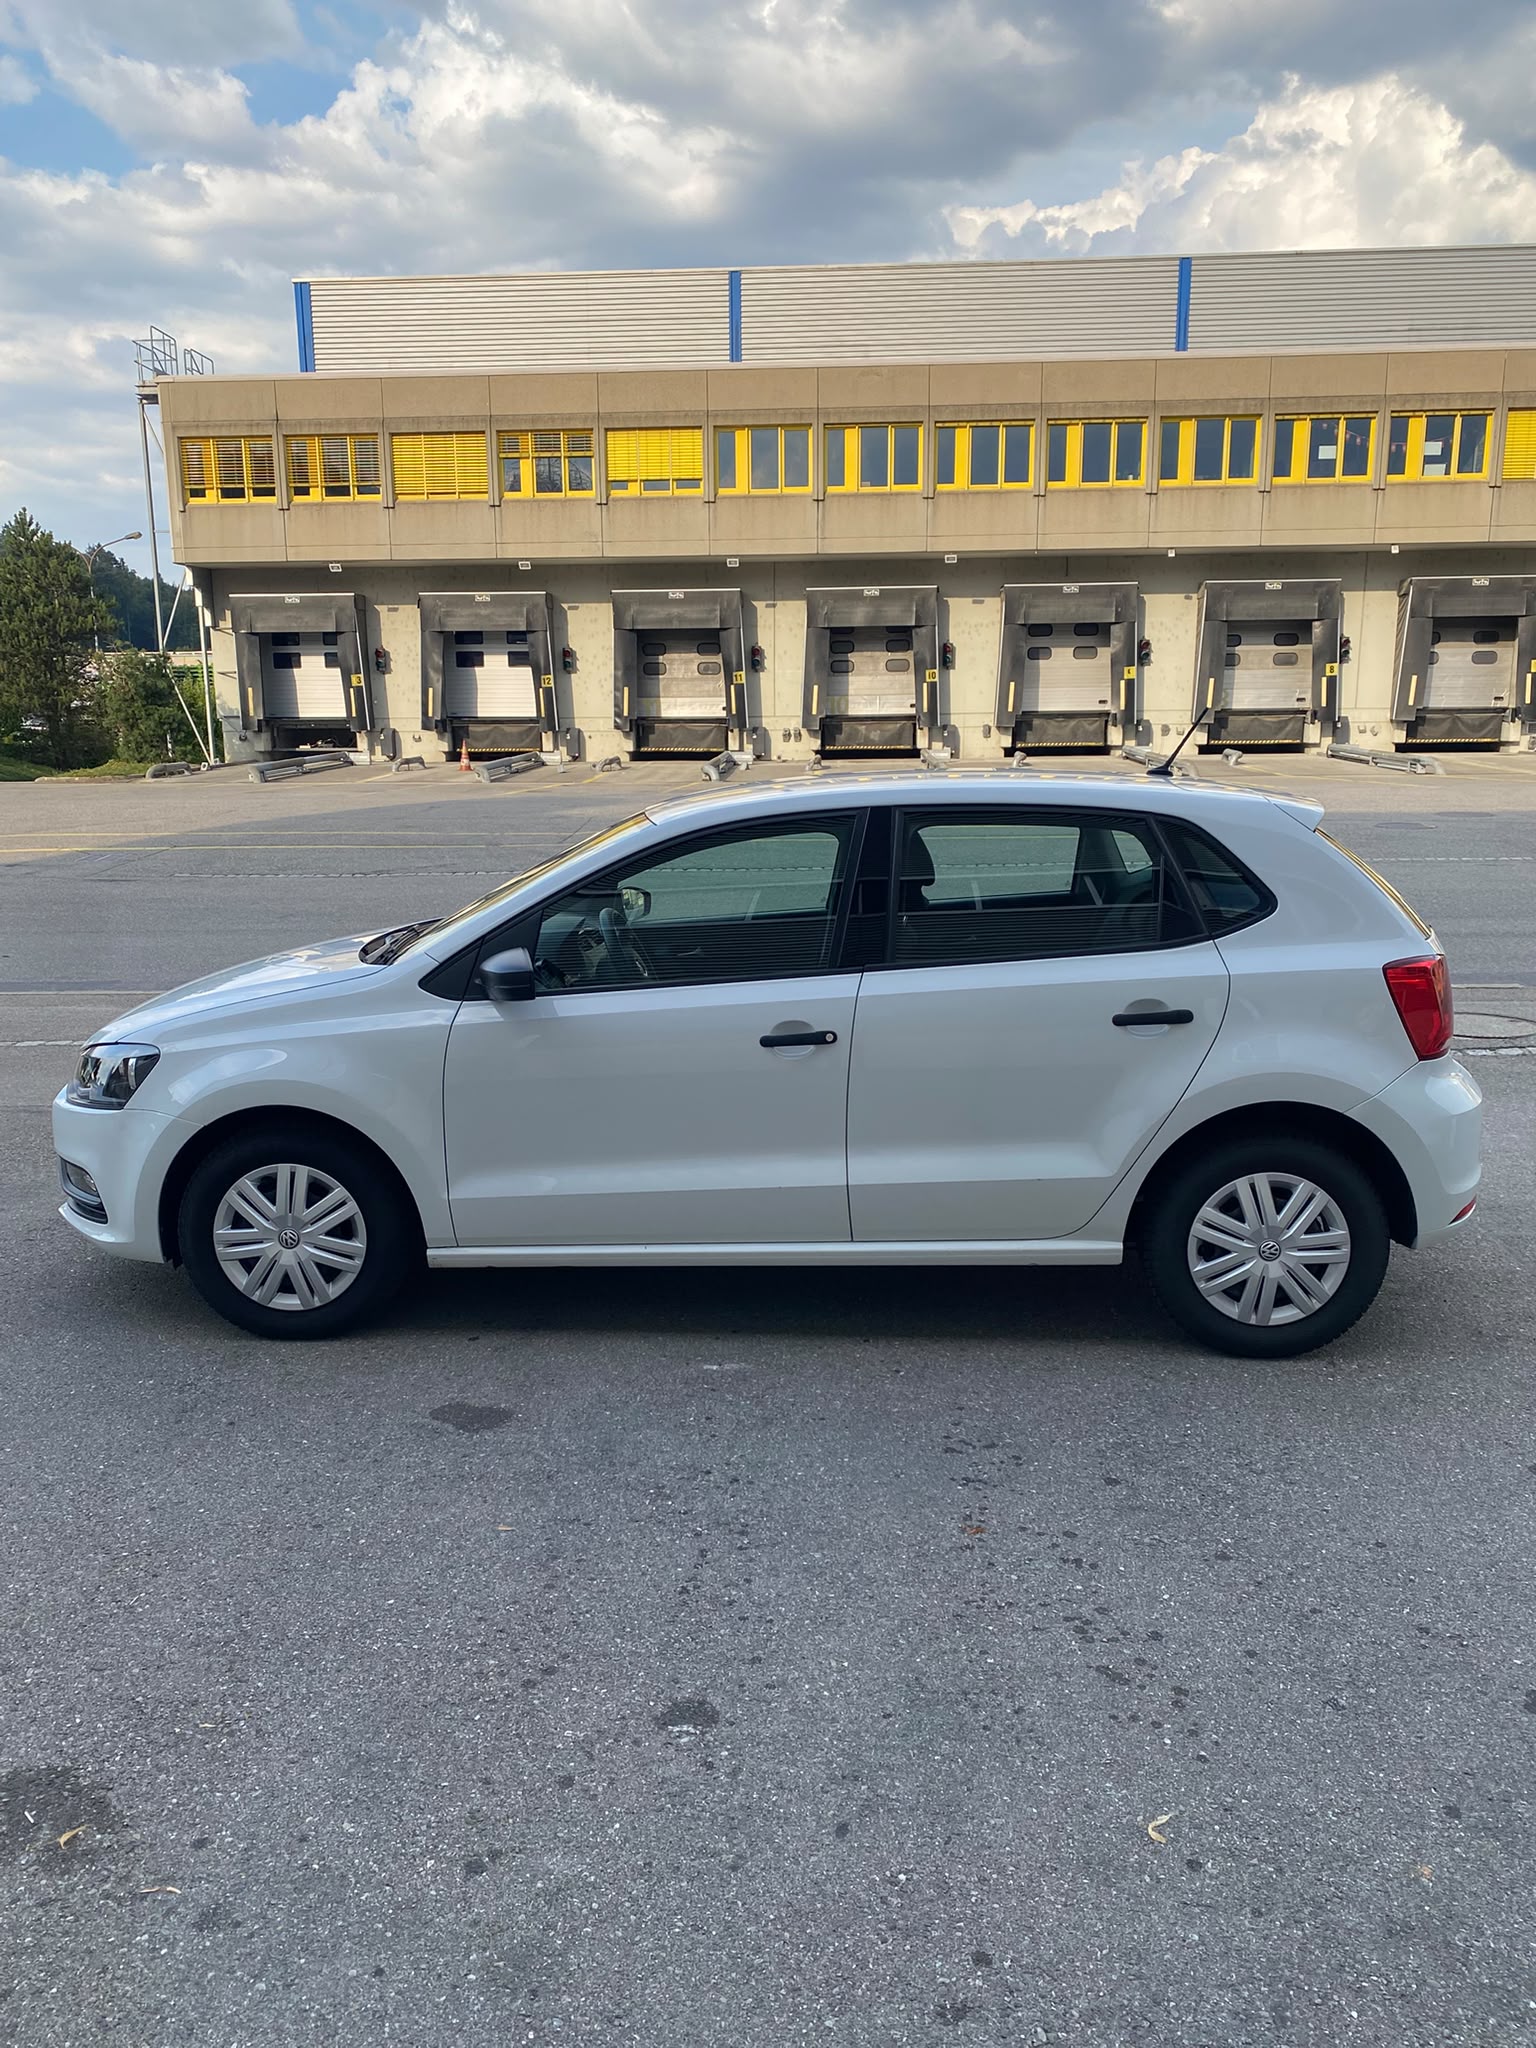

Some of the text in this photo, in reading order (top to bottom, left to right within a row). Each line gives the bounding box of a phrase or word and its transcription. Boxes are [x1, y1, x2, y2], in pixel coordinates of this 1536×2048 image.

[734, 673, 743, 682] 11
[927, 671, 937, 680] 10
[542, 677, 552, 686] 12
[280, 1229, 299, 1248] VW
[1260, 1241, 1280, 1260] VW
